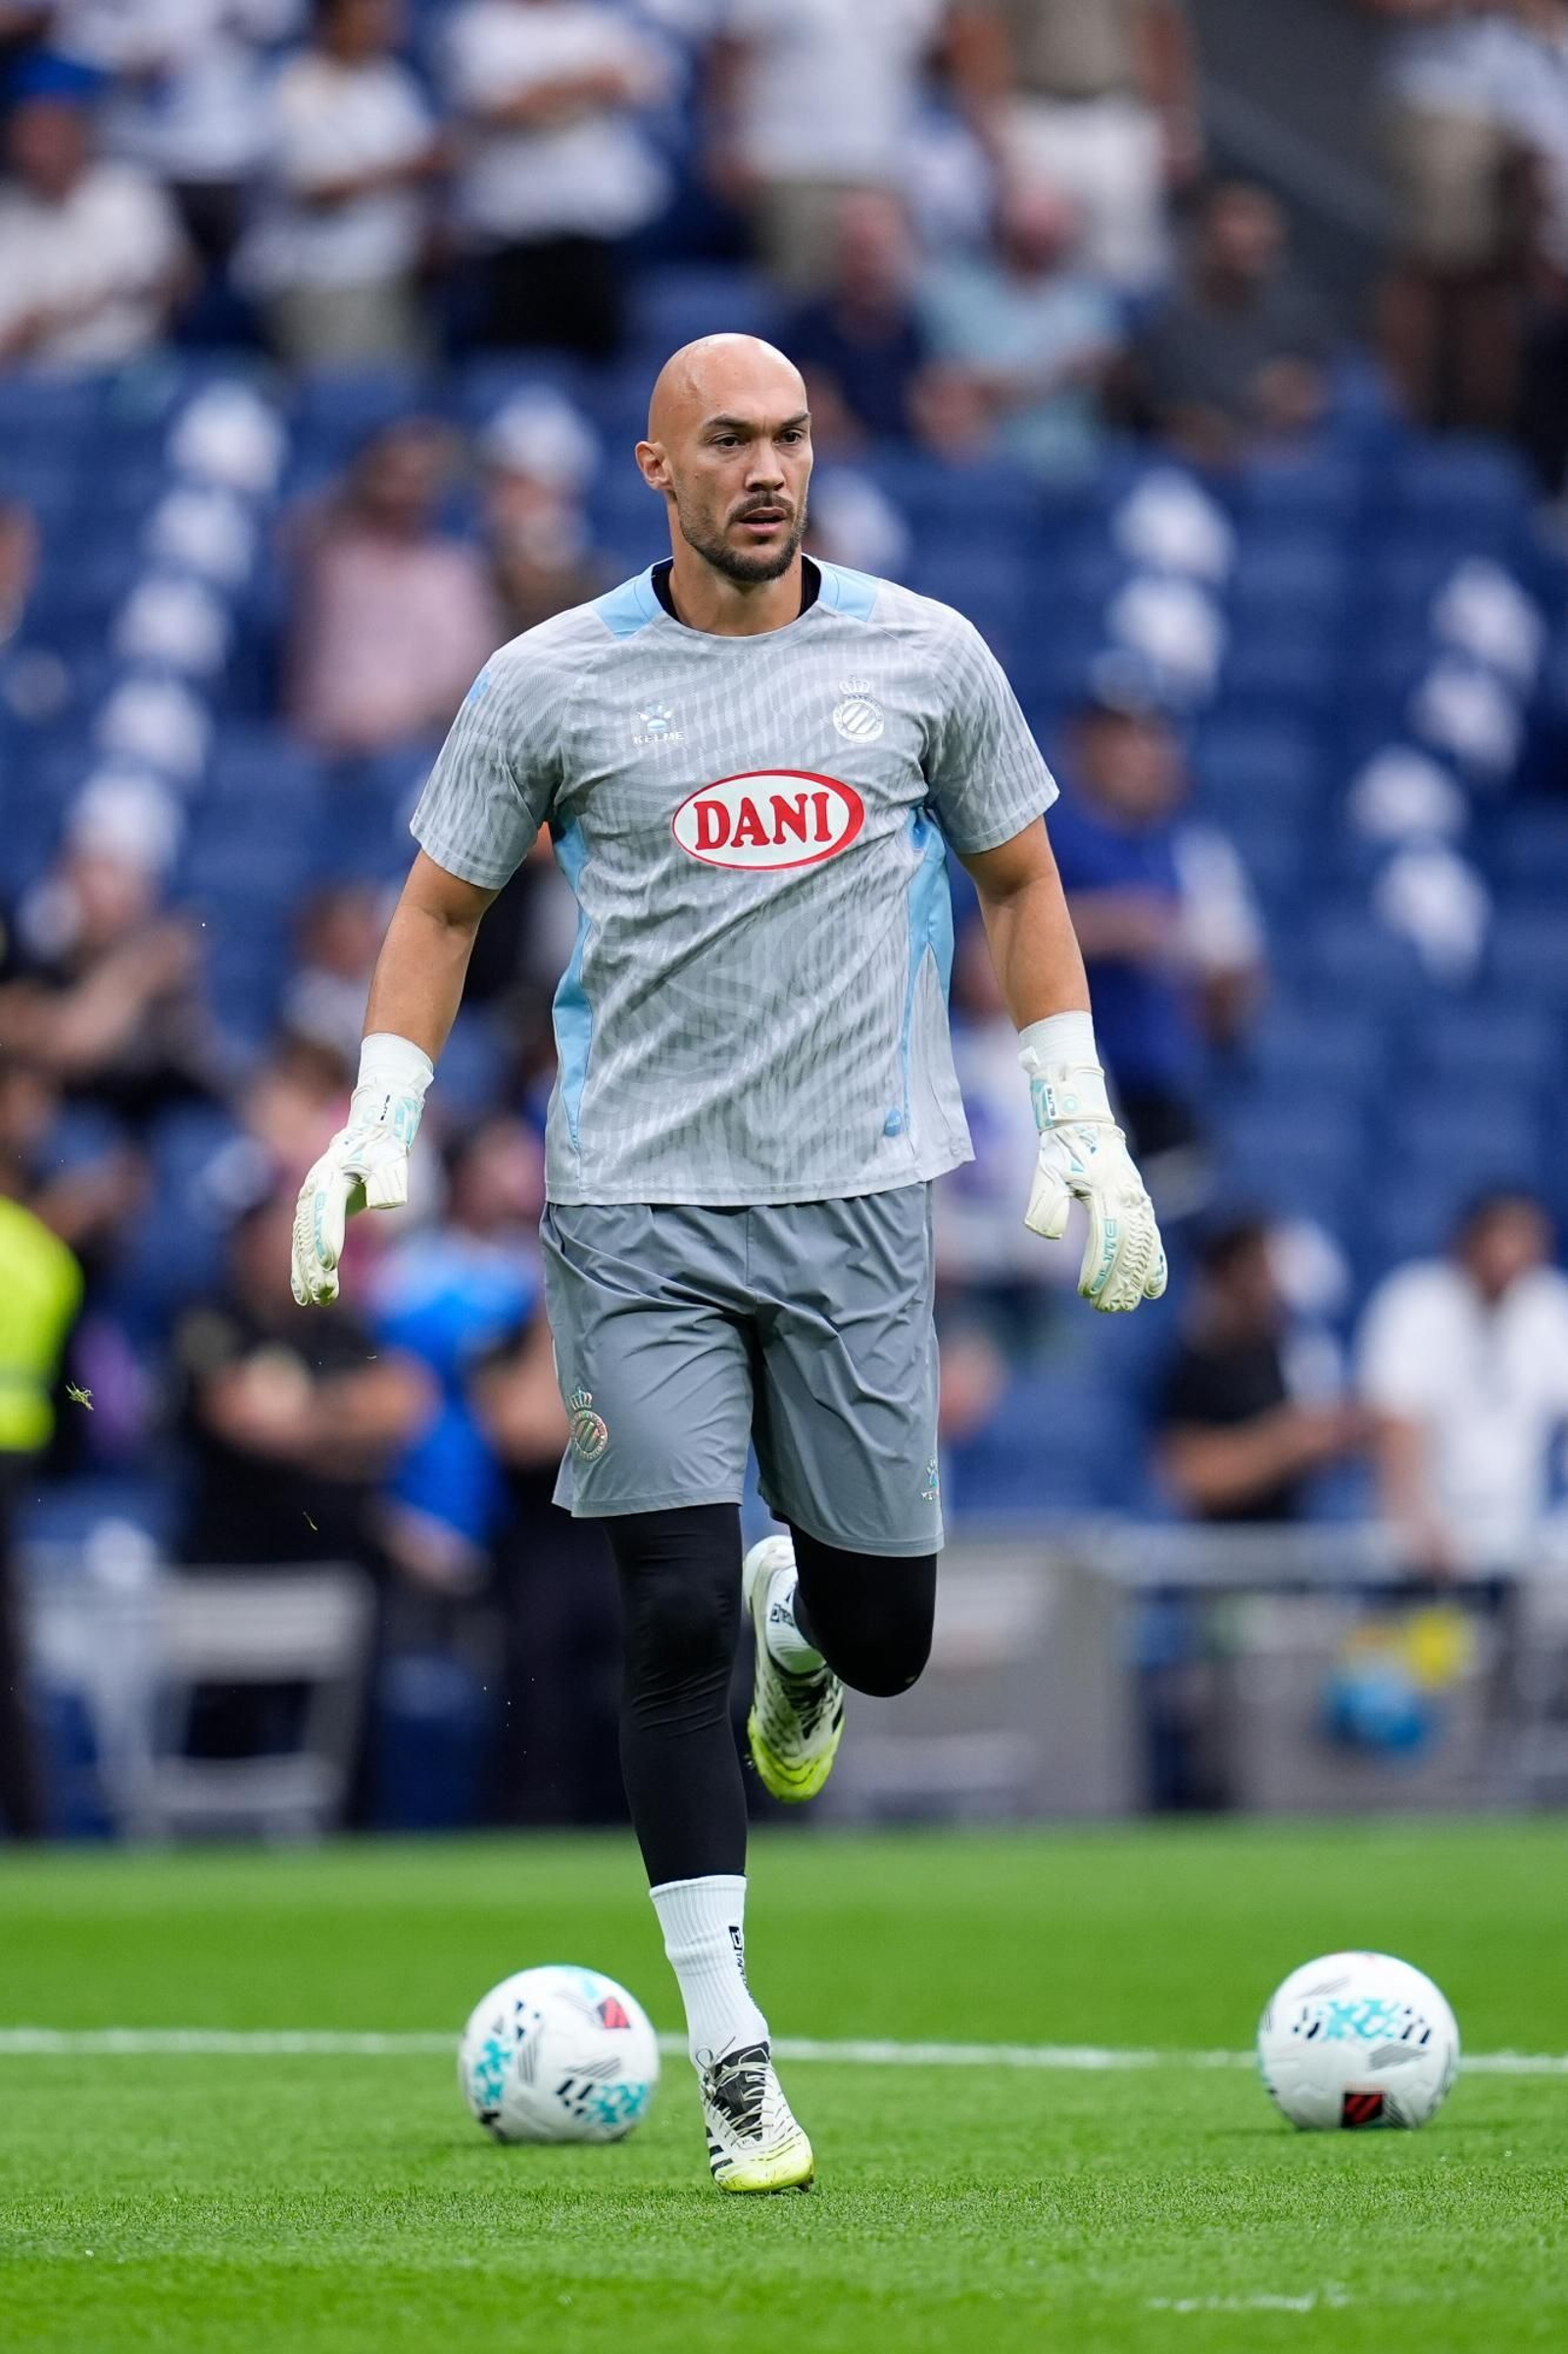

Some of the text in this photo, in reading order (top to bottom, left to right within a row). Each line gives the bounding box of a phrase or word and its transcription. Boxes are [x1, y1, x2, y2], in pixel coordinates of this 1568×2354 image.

[633, 731, 685, 745] KELME
[693, 792, 832, 851] DANI
[1092, 1219, 1117, 1293] ELITE
